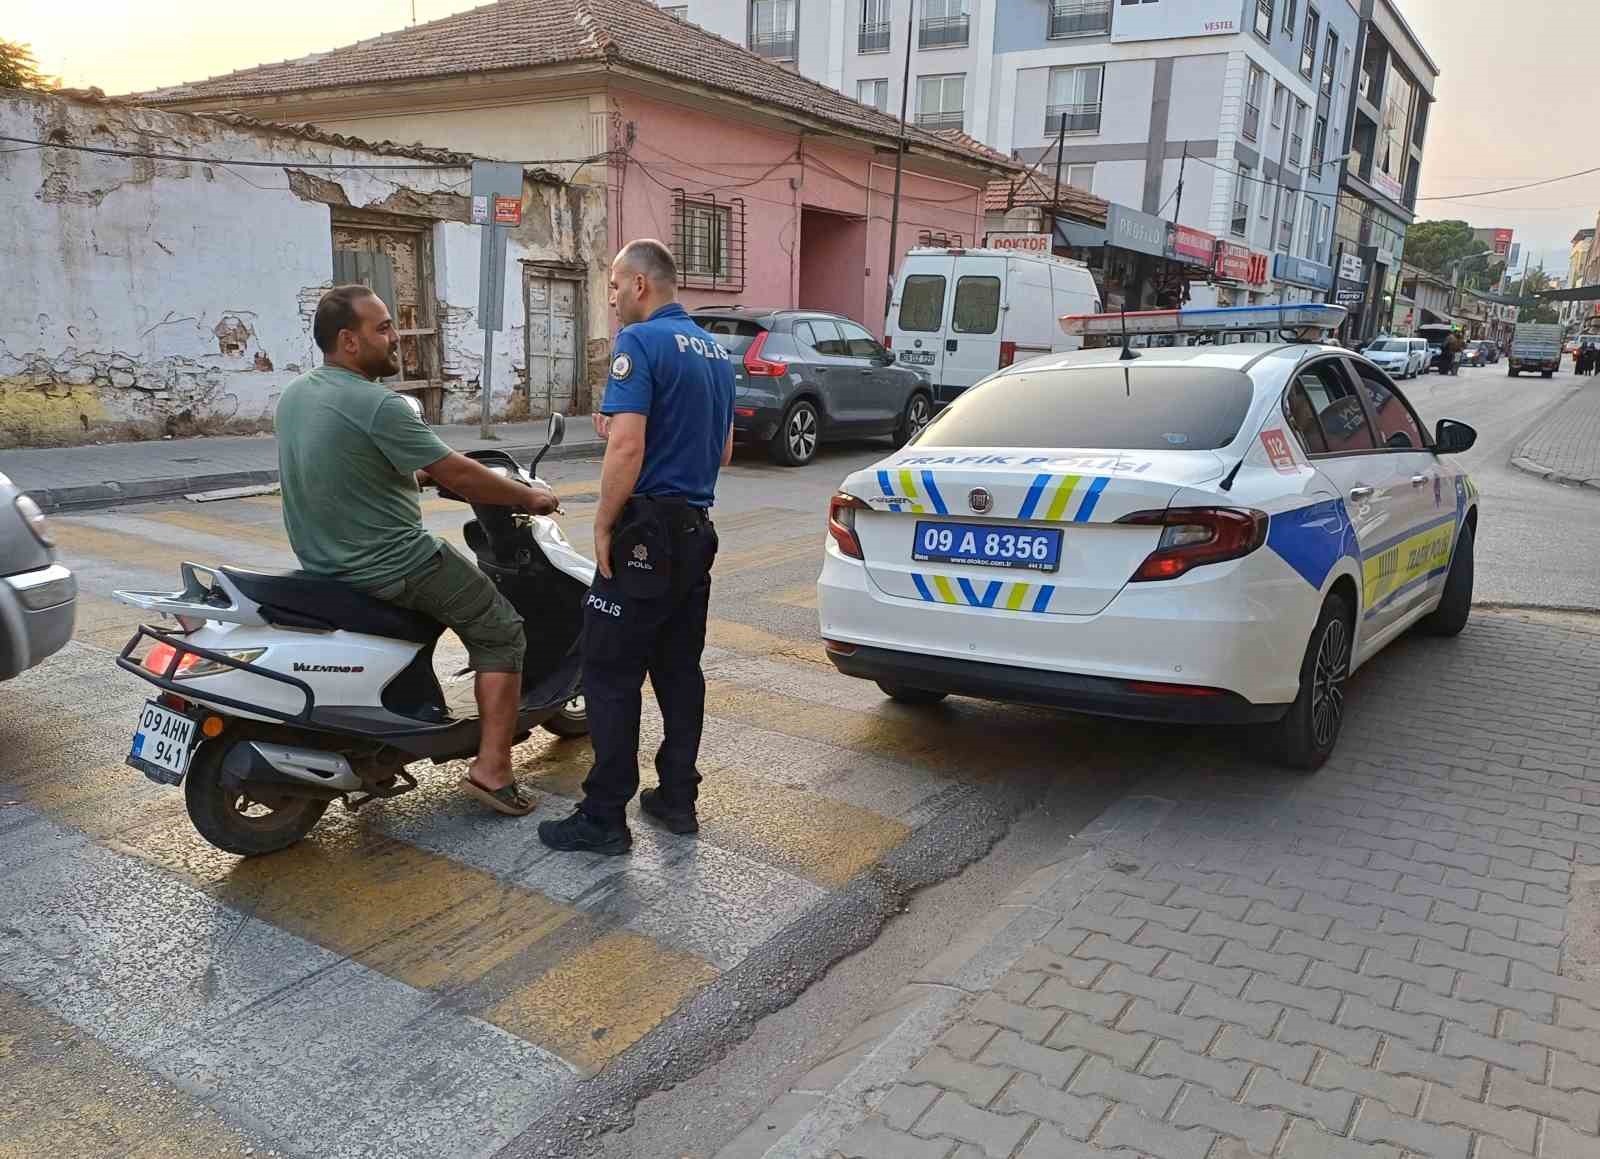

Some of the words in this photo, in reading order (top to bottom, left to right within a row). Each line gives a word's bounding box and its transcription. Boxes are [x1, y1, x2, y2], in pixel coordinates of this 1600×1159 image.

[1204, 20, 1233, 31] VESTEL
[924, 528, 953, 551] 09
[958, 531, 977, 554] A
[984, 533, 1049, 560] 8356
[154, 741, 182, 768] 941
